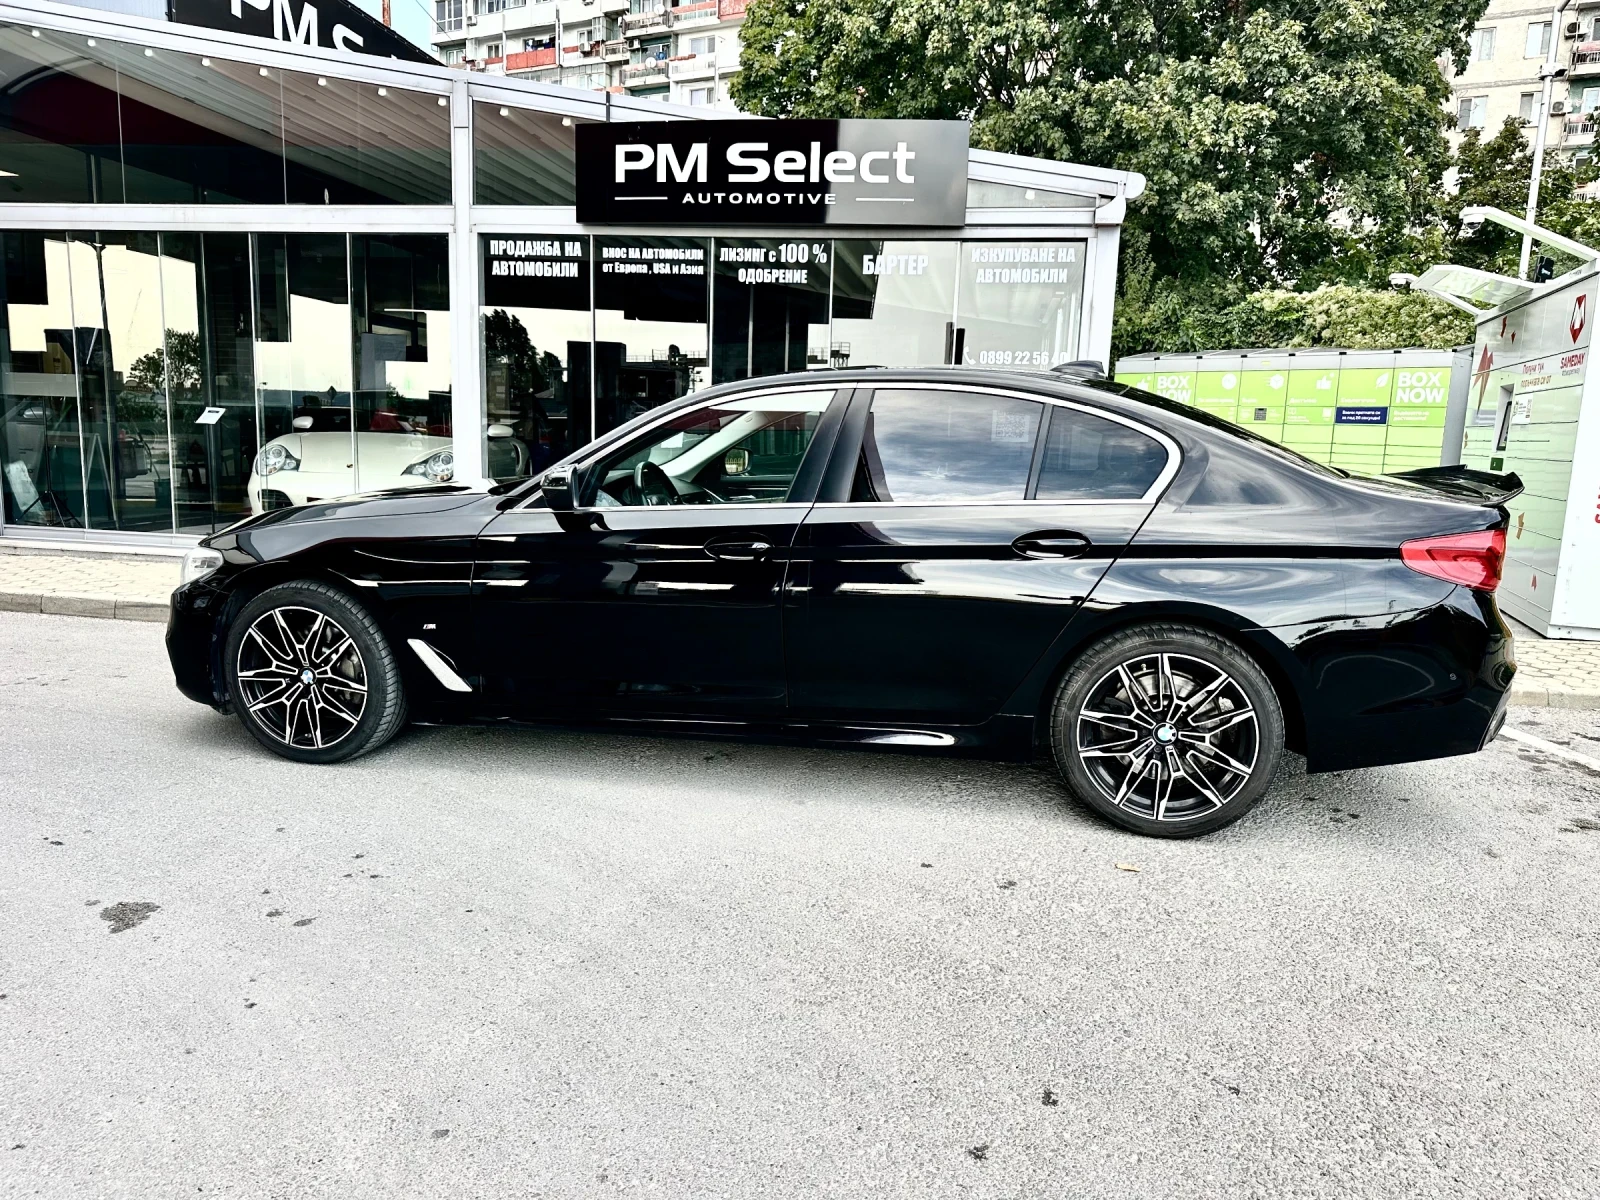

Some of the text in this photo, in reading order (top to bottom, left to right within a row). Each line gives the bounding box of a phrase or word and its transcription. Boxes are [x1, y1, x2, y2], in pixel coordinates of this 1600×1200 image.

[615, 141, 916, 184] PM Select
[682, 192, 837, 205] AUTOMOTIVE
[490, 240, 582, 258] ПРОДАЖБА НА
[628, 248, 641, 259] НА
[641, 248, 704, 260] АВТОМОБИЛИ
[719, 247, 767, 262] ЛИЗИНГ
[778, 243, 809, 264] 100
[812, 243, 828, 264] %
[971, 248, 1076, 263] ИЗКУПУВАНЕ НА
[491, 260, 578, 277] АВТОМОБИЛИ
[602, 263, 613, 273] от
[653, 262, 671, 274] USA
[672, 264, 679, 274] и
[680, 263, 704, 275] Азия
[862, 255, 929, 275] БАРТЕР
[738, 268, 808, 285] ОДОБРЕНИЕ
[976, 268, 1068, 284] АВТОМОБИЛИ
[979, 350, 1012, 365] 0899
[1014, 350, 1030, 365] 22
[1032, 351, 1049, 365] 56
[1560, 352, 1585, 369] SAMEDAY
[1157, 375, 1191, 389] BOX
[1398, 371, 1443, 387] BOX
[1396, 387, 1445, 403] NOW
